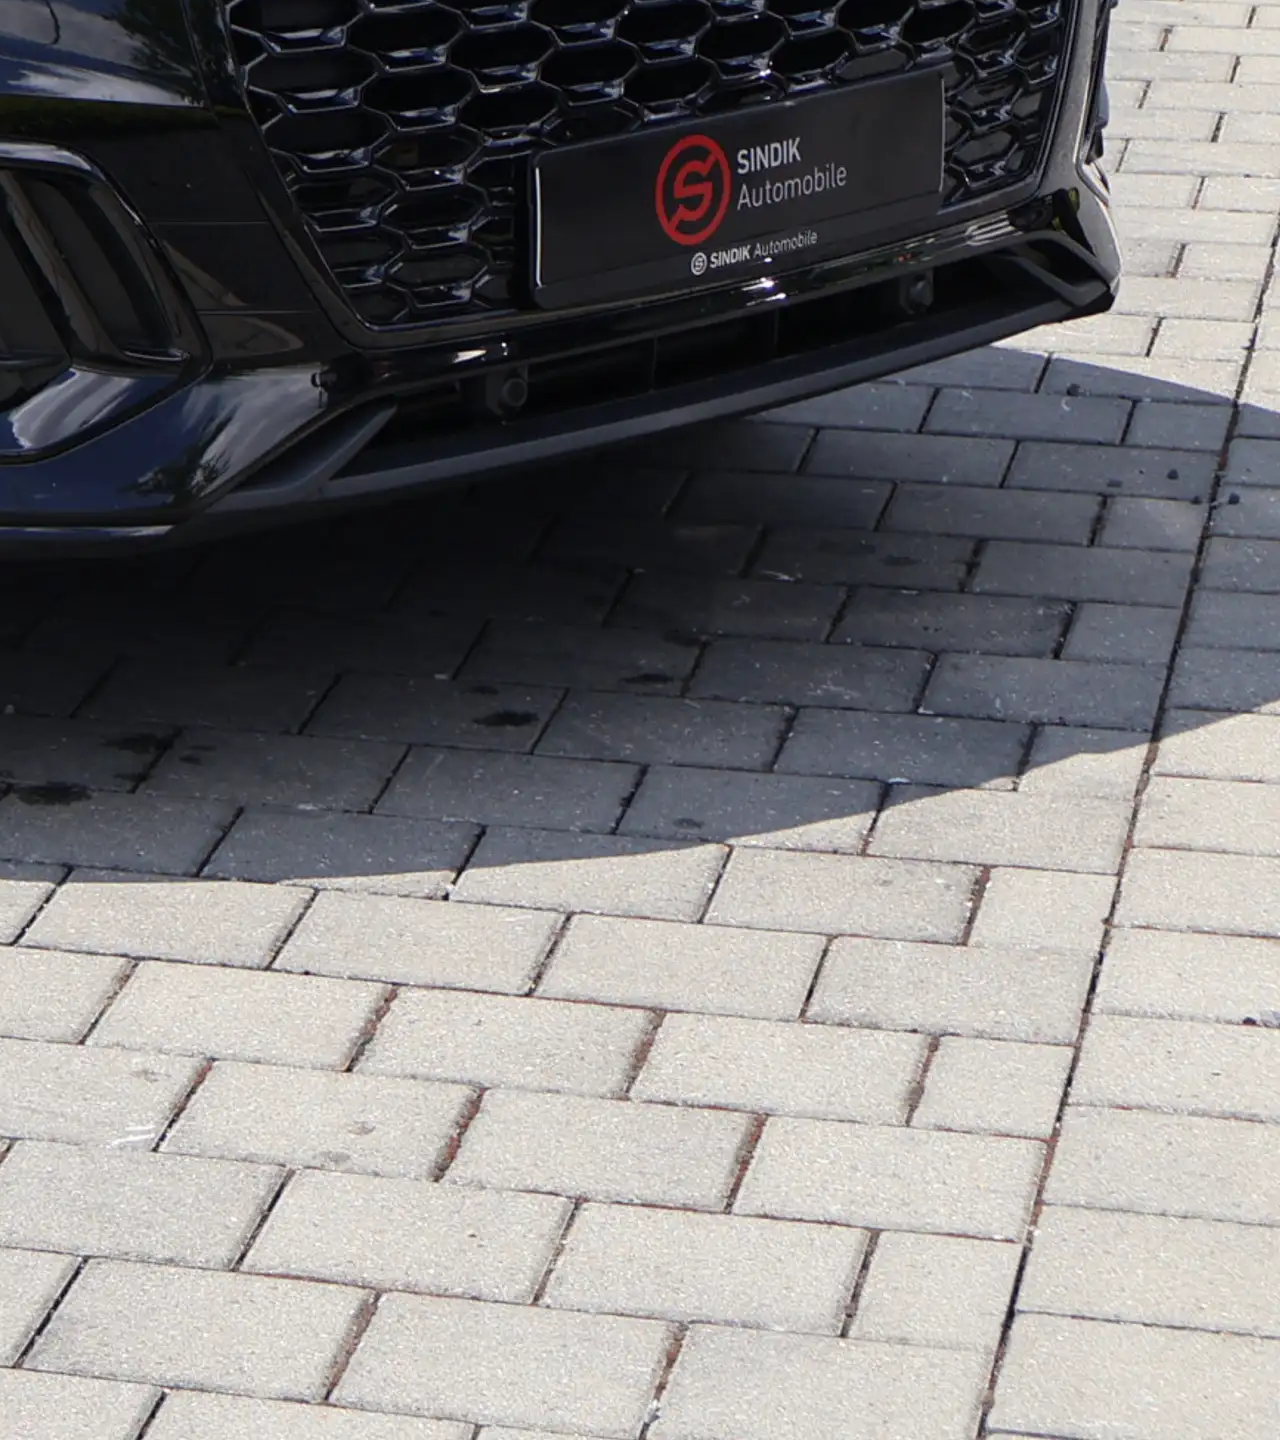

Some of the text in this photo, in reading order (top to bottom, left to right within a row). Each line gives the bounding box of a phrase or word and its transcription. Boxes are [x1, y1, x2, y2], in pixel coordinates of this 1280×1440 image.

[737, 137, 802, 174] SINDIK
[737, 162, 848, 210] Automobile
[709, 244, 752, 269] SINDIK
[753, 229, 819, 257] Automobile
